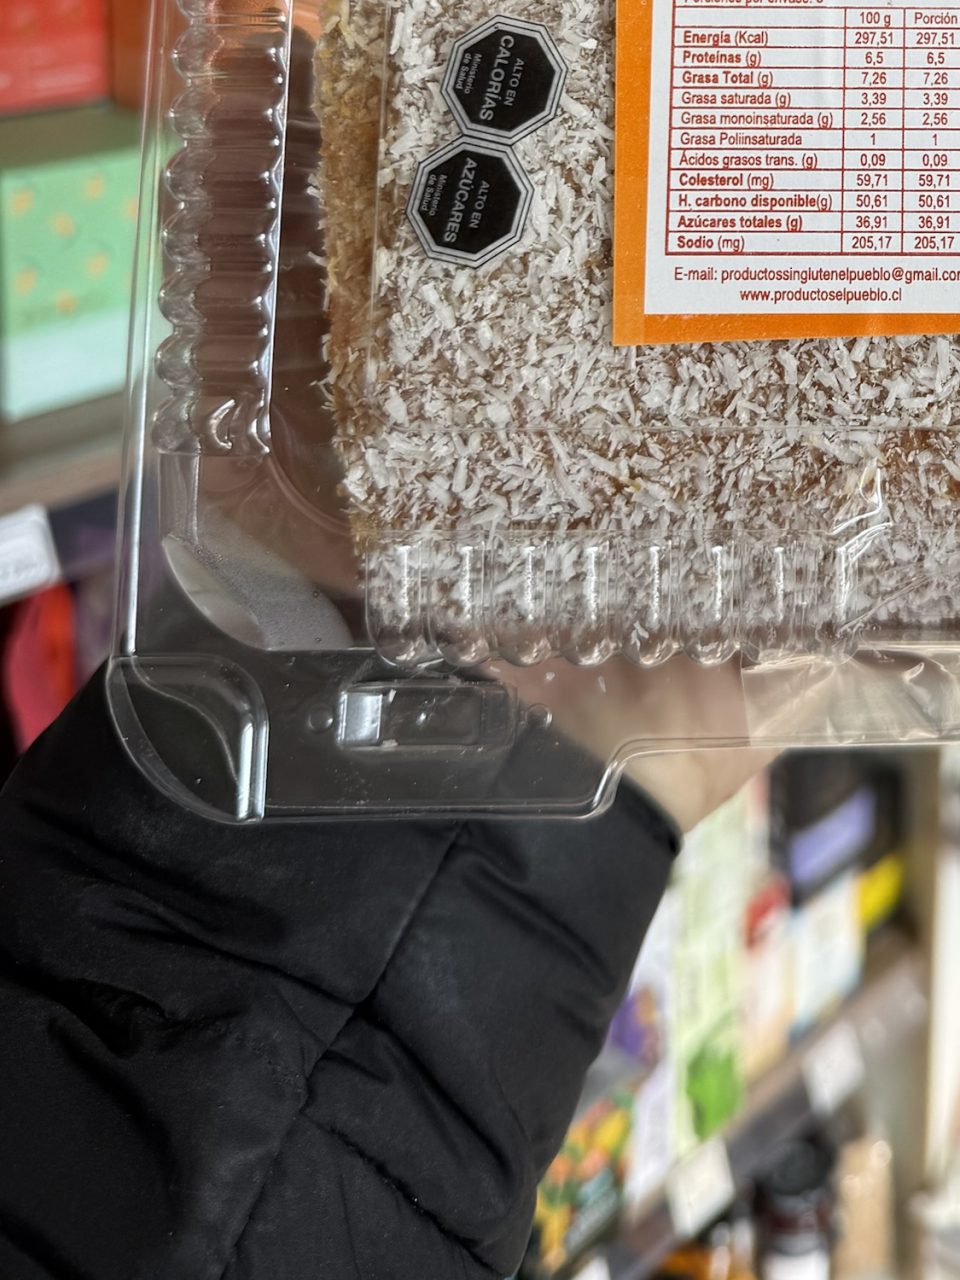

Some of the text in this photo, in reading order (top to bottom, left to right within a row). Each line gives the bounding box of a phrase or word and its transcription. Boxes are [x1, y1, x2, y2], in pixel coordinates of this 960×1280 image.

[860, 12, 958, 27] 100 g Porción
[682, 30, 768, 46] Energía (Kcal)
[855, 32, 954, 47] 297,51 297,51
[683, 50, 945, 66] Proteínas (g) 6,5 6,5
[456, 53, 472, 89] de Salud
[464, 54, 482, 94] Ministerio
[479, 35, 515, 120] CALORÍAS
[504, 58, 524, 107] ALTO EN
[682, 71, 949, 88] Grasa Total (g) 7,26 7,26
[680, 92, 948, 108] Grasa saturada (g) 3,39 3,39
[681, 112, 948, 128] Grasa monoinsaturada (g) 2,56 2,56
[680, 132, 937, 146] Grasa Poliinsaturada 1 1
[679, 150, 948, 169] Ácidos grasos trans. (g) 0,09 0,09
[679, 173, 950, 189] Colesterol (mg) 59,71 59,71
[422, 174, 437, 211] de Salud
[429, 175, 447, 216] Ministerio
[443, 158, 478, 243] AZÚCARES
[469, 180, 490, 229] ALTO EN
[679, 194, 949, 210] H. carbono disponible(g) 50,61 50,61
[677, 215, 949, 231] Azúcares totales (g) 36,91 36,91
[677, 236, 954, 251] Sodio (mg) 205,17 205,17
[674, 267, 717, 280] E-mail:
[740, 288, 901, 304] www.productoselpueblo.cl
